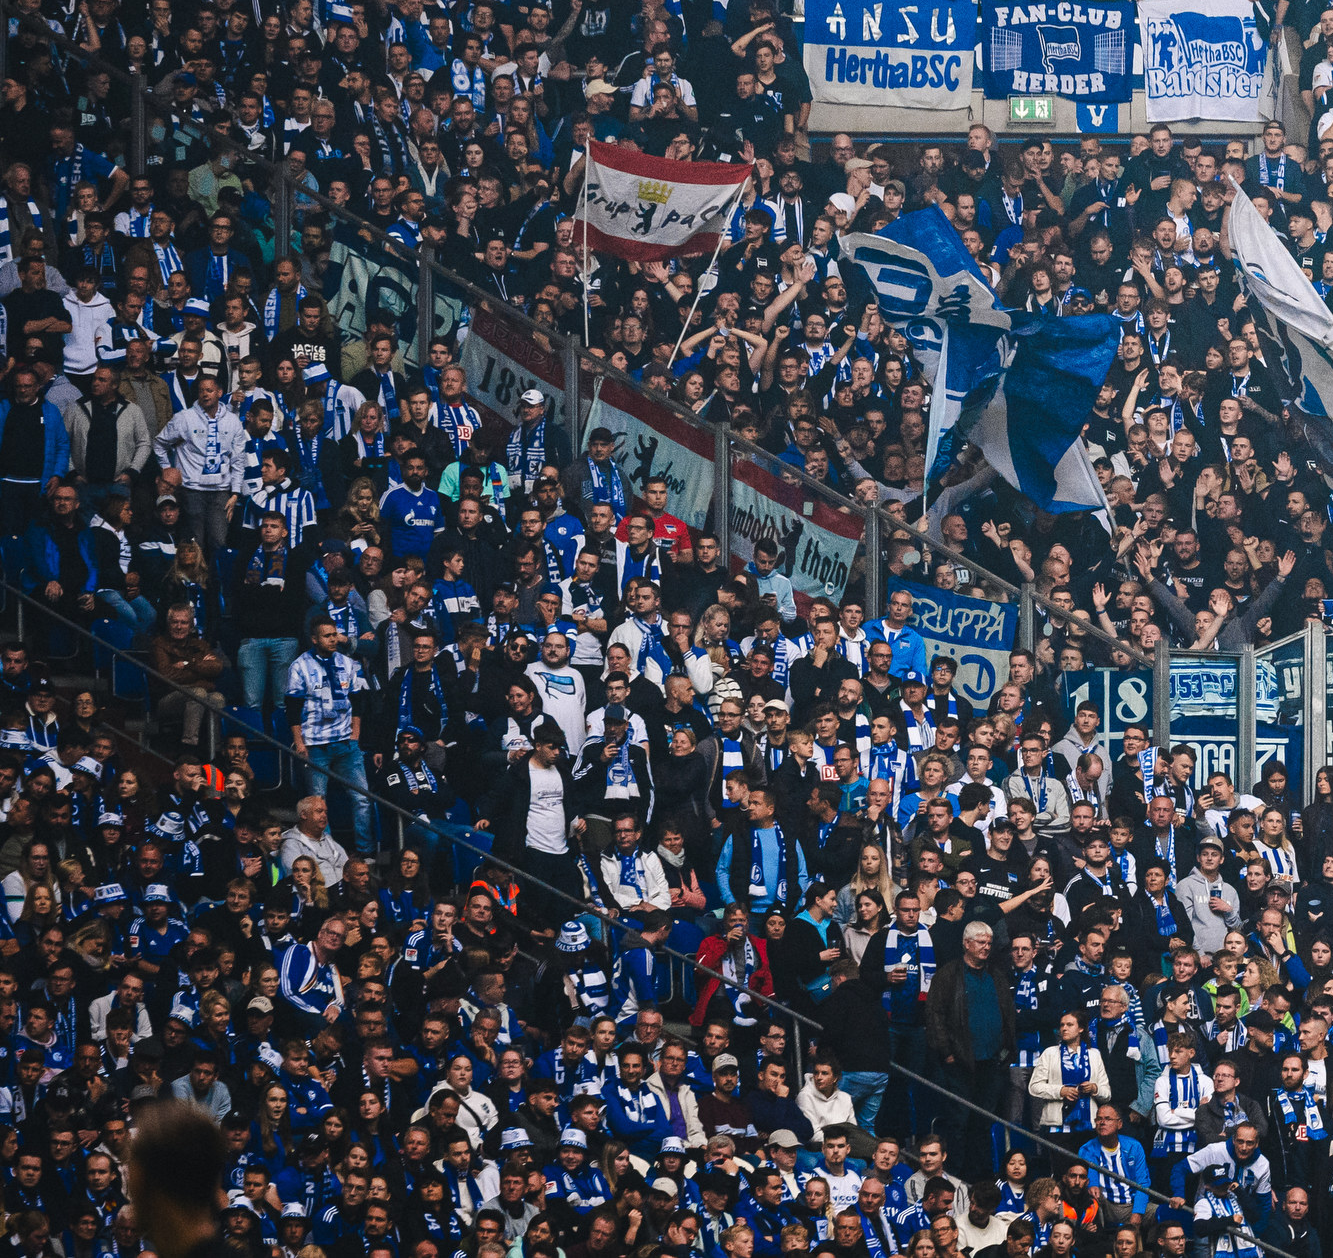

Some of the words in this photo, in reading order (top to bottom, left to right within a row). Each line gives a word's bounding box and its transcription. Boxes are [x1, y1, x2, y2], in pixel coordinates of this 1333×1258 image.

[997, 1, 1122, 30] FAN-CLUB
[824, 46, 962, 93] HerthaBSC
[1012, 69, 1106, 96] HERDER
[904, 598, 1005, 642] GRUPPA
